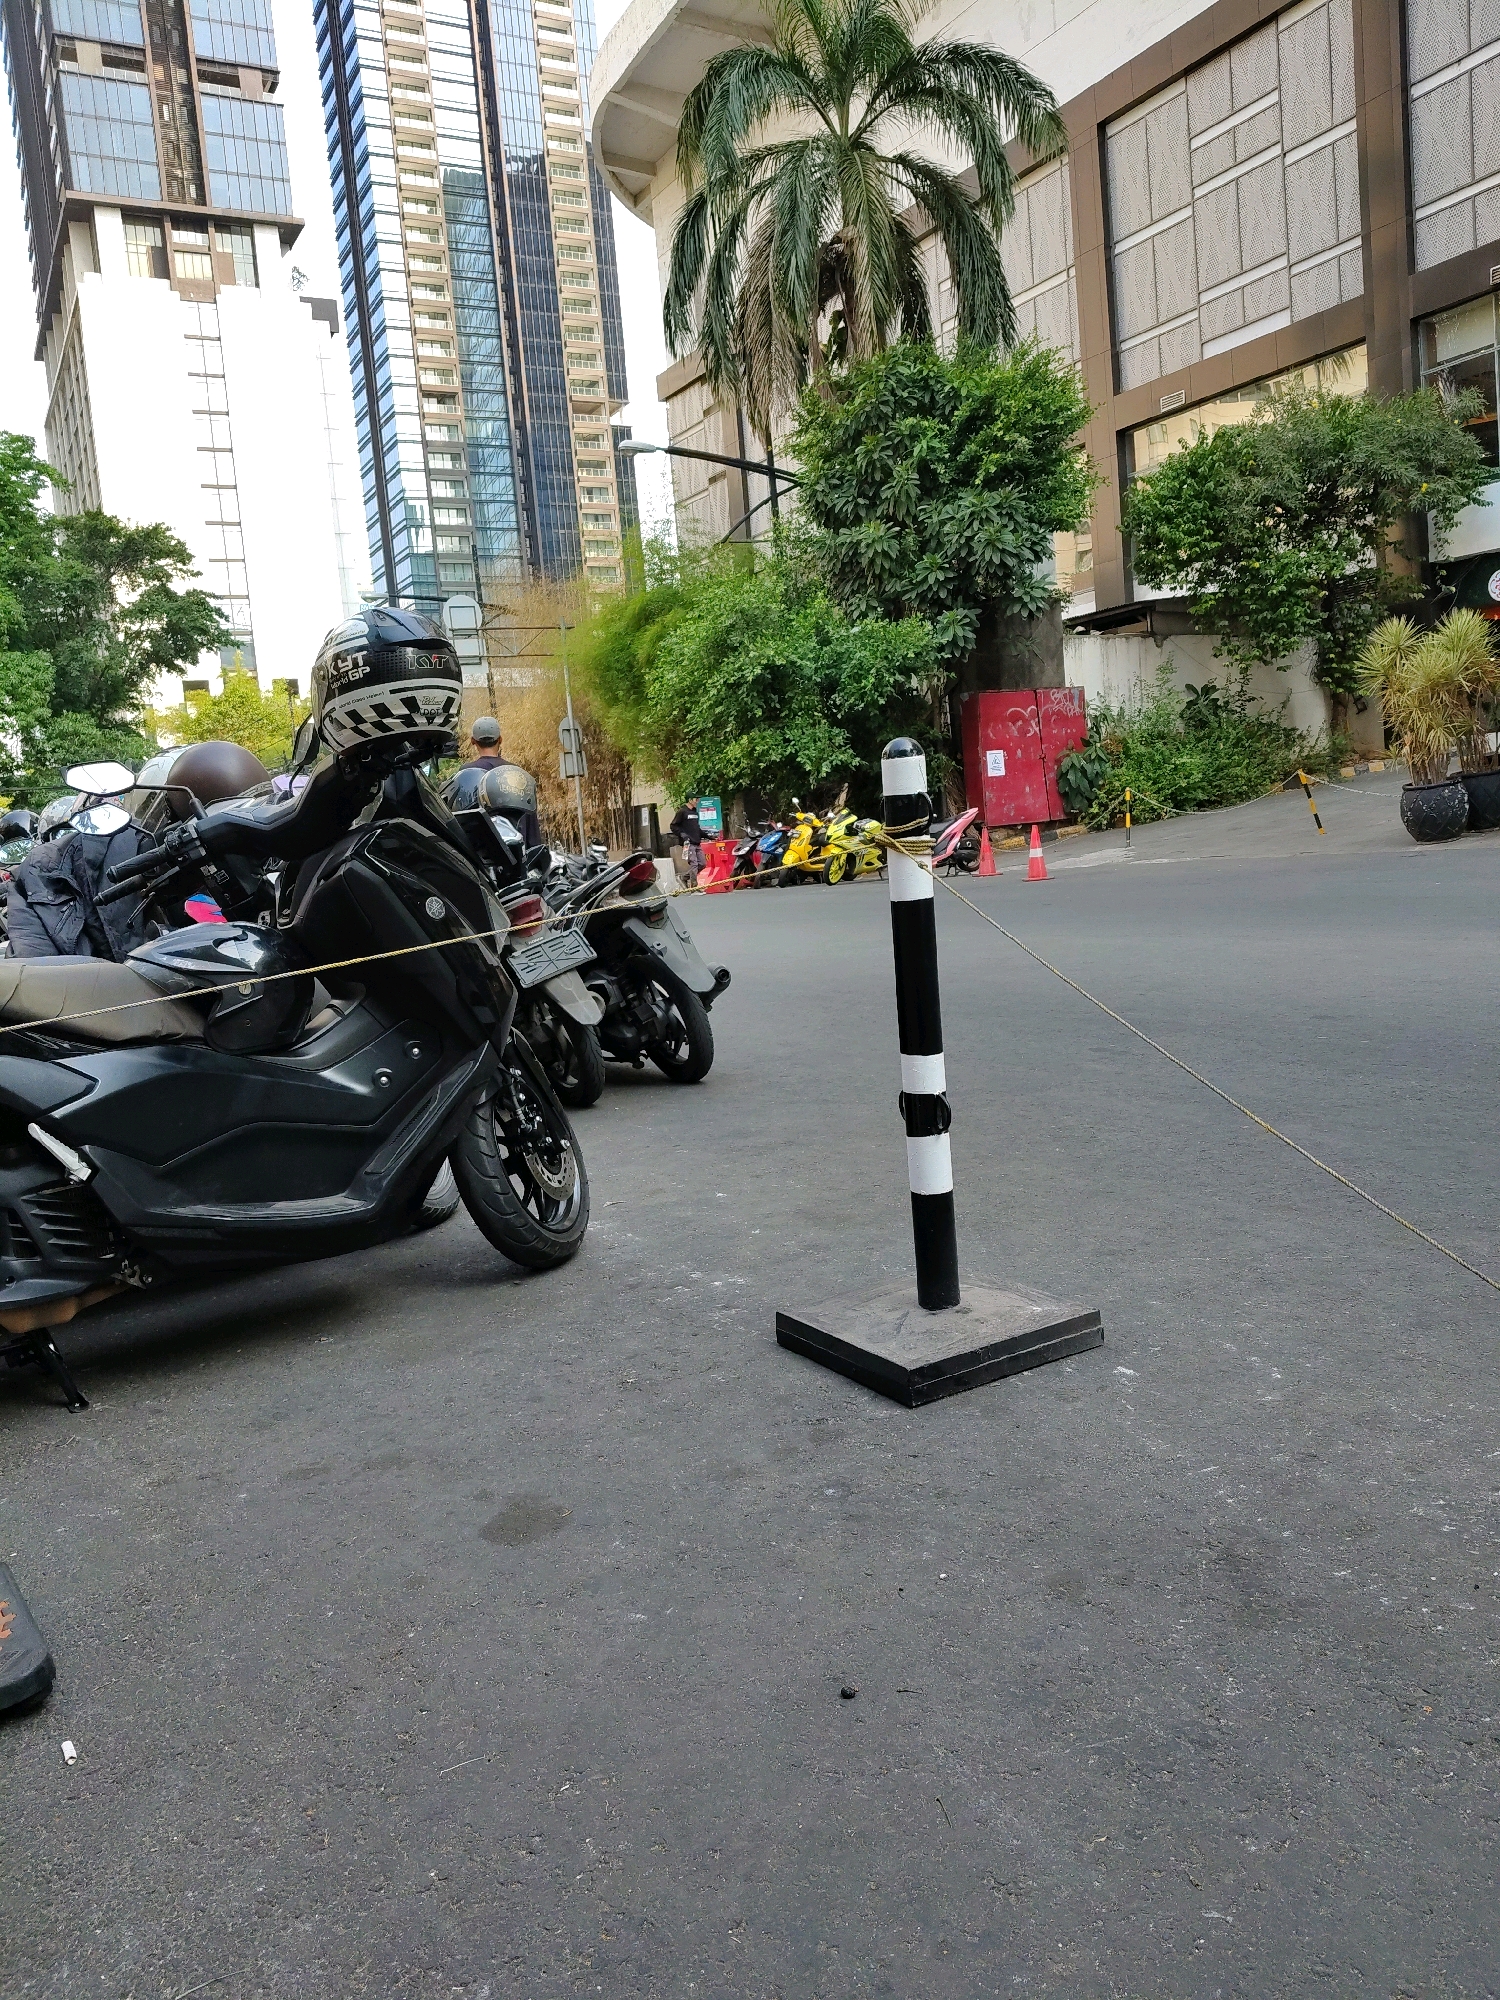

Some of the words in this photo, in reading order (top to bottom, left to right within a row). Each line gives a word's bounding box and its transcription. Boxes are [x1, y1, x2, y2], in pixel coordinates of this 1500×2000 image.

[328, 651, 368, 679] KYT
[405, 653, 450, 670] KYT
[330, 676, 348, 689] World
[348, 666, 371, 681] GP
